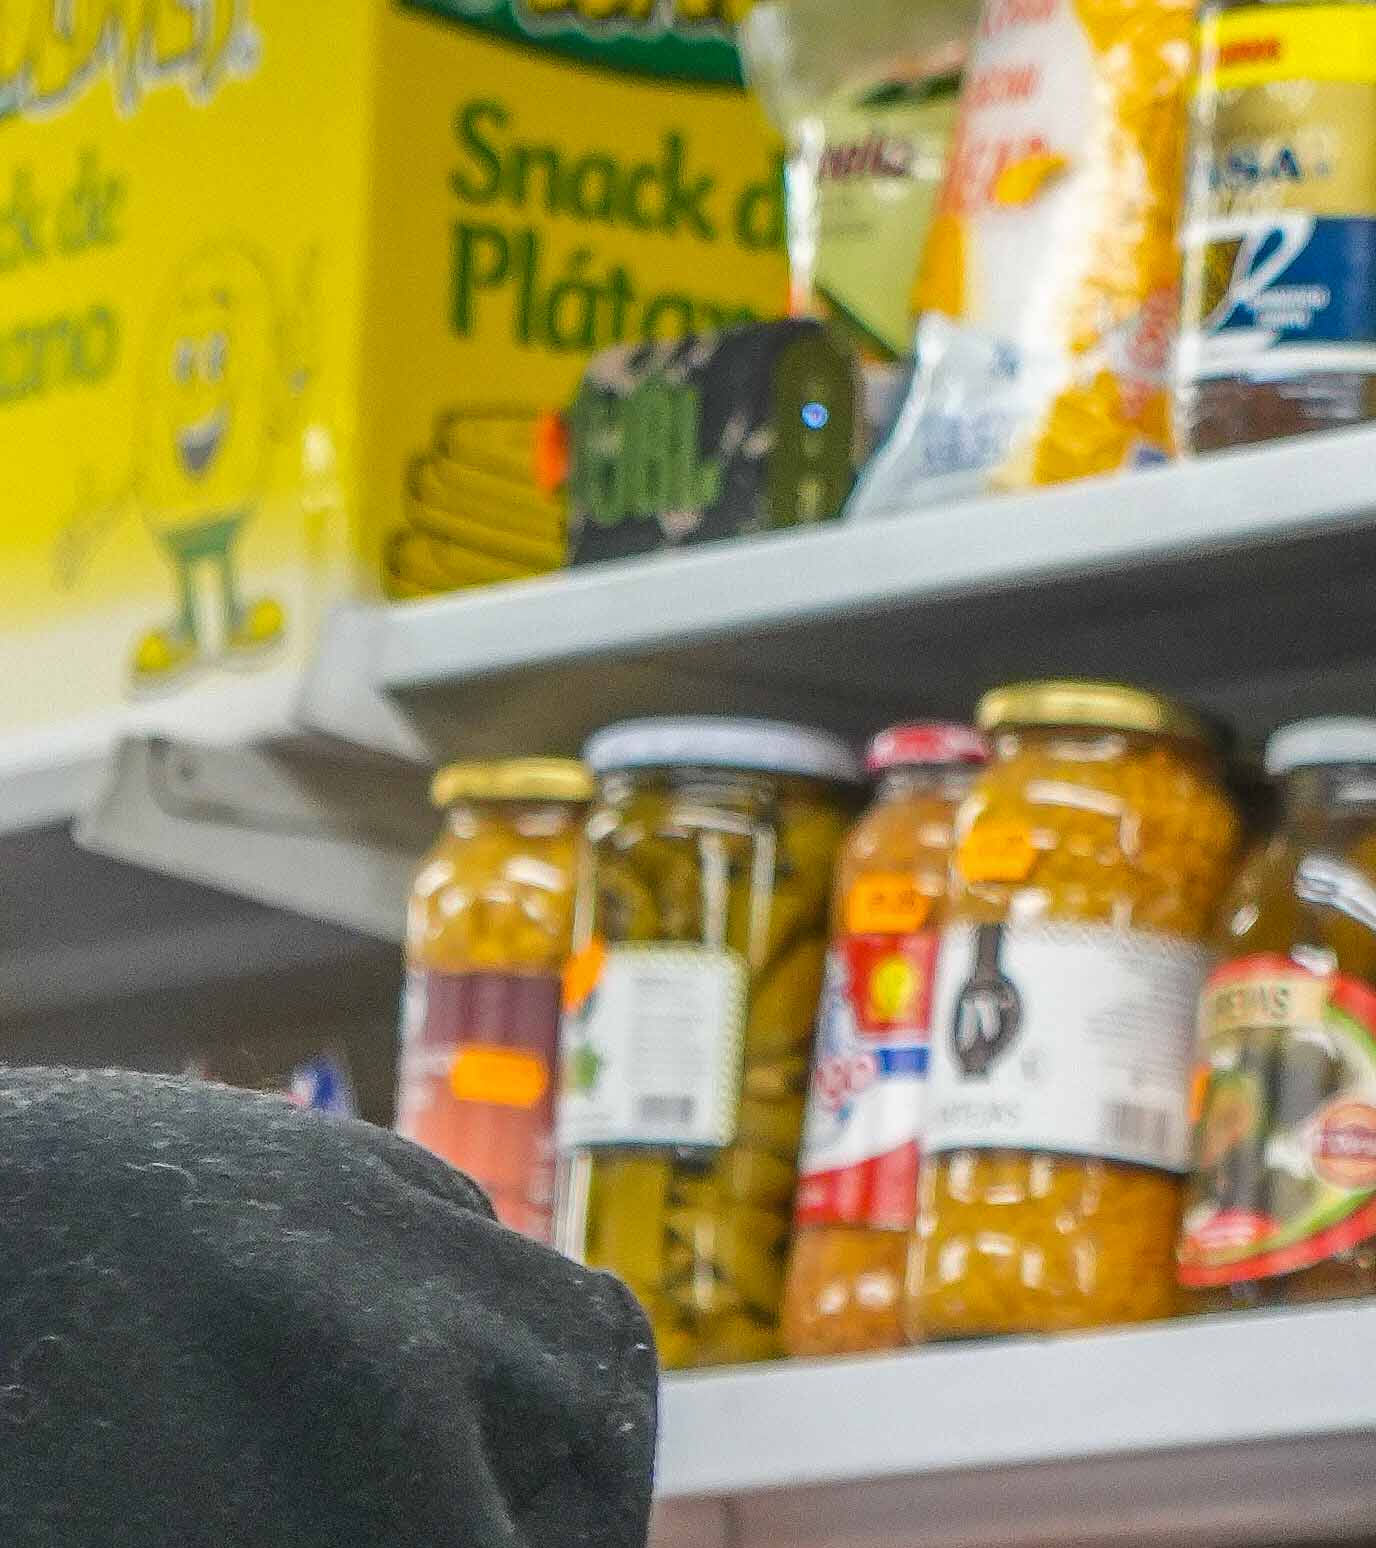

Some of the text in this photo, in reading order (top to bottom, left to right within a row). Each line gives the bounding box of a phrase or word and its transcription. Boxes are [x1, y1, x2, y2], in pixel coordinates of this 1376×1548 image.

[52, 144, 127, 256] de
[448, 98, 787, 254] Snack d
[449, 219, 759, 356] Pláta
